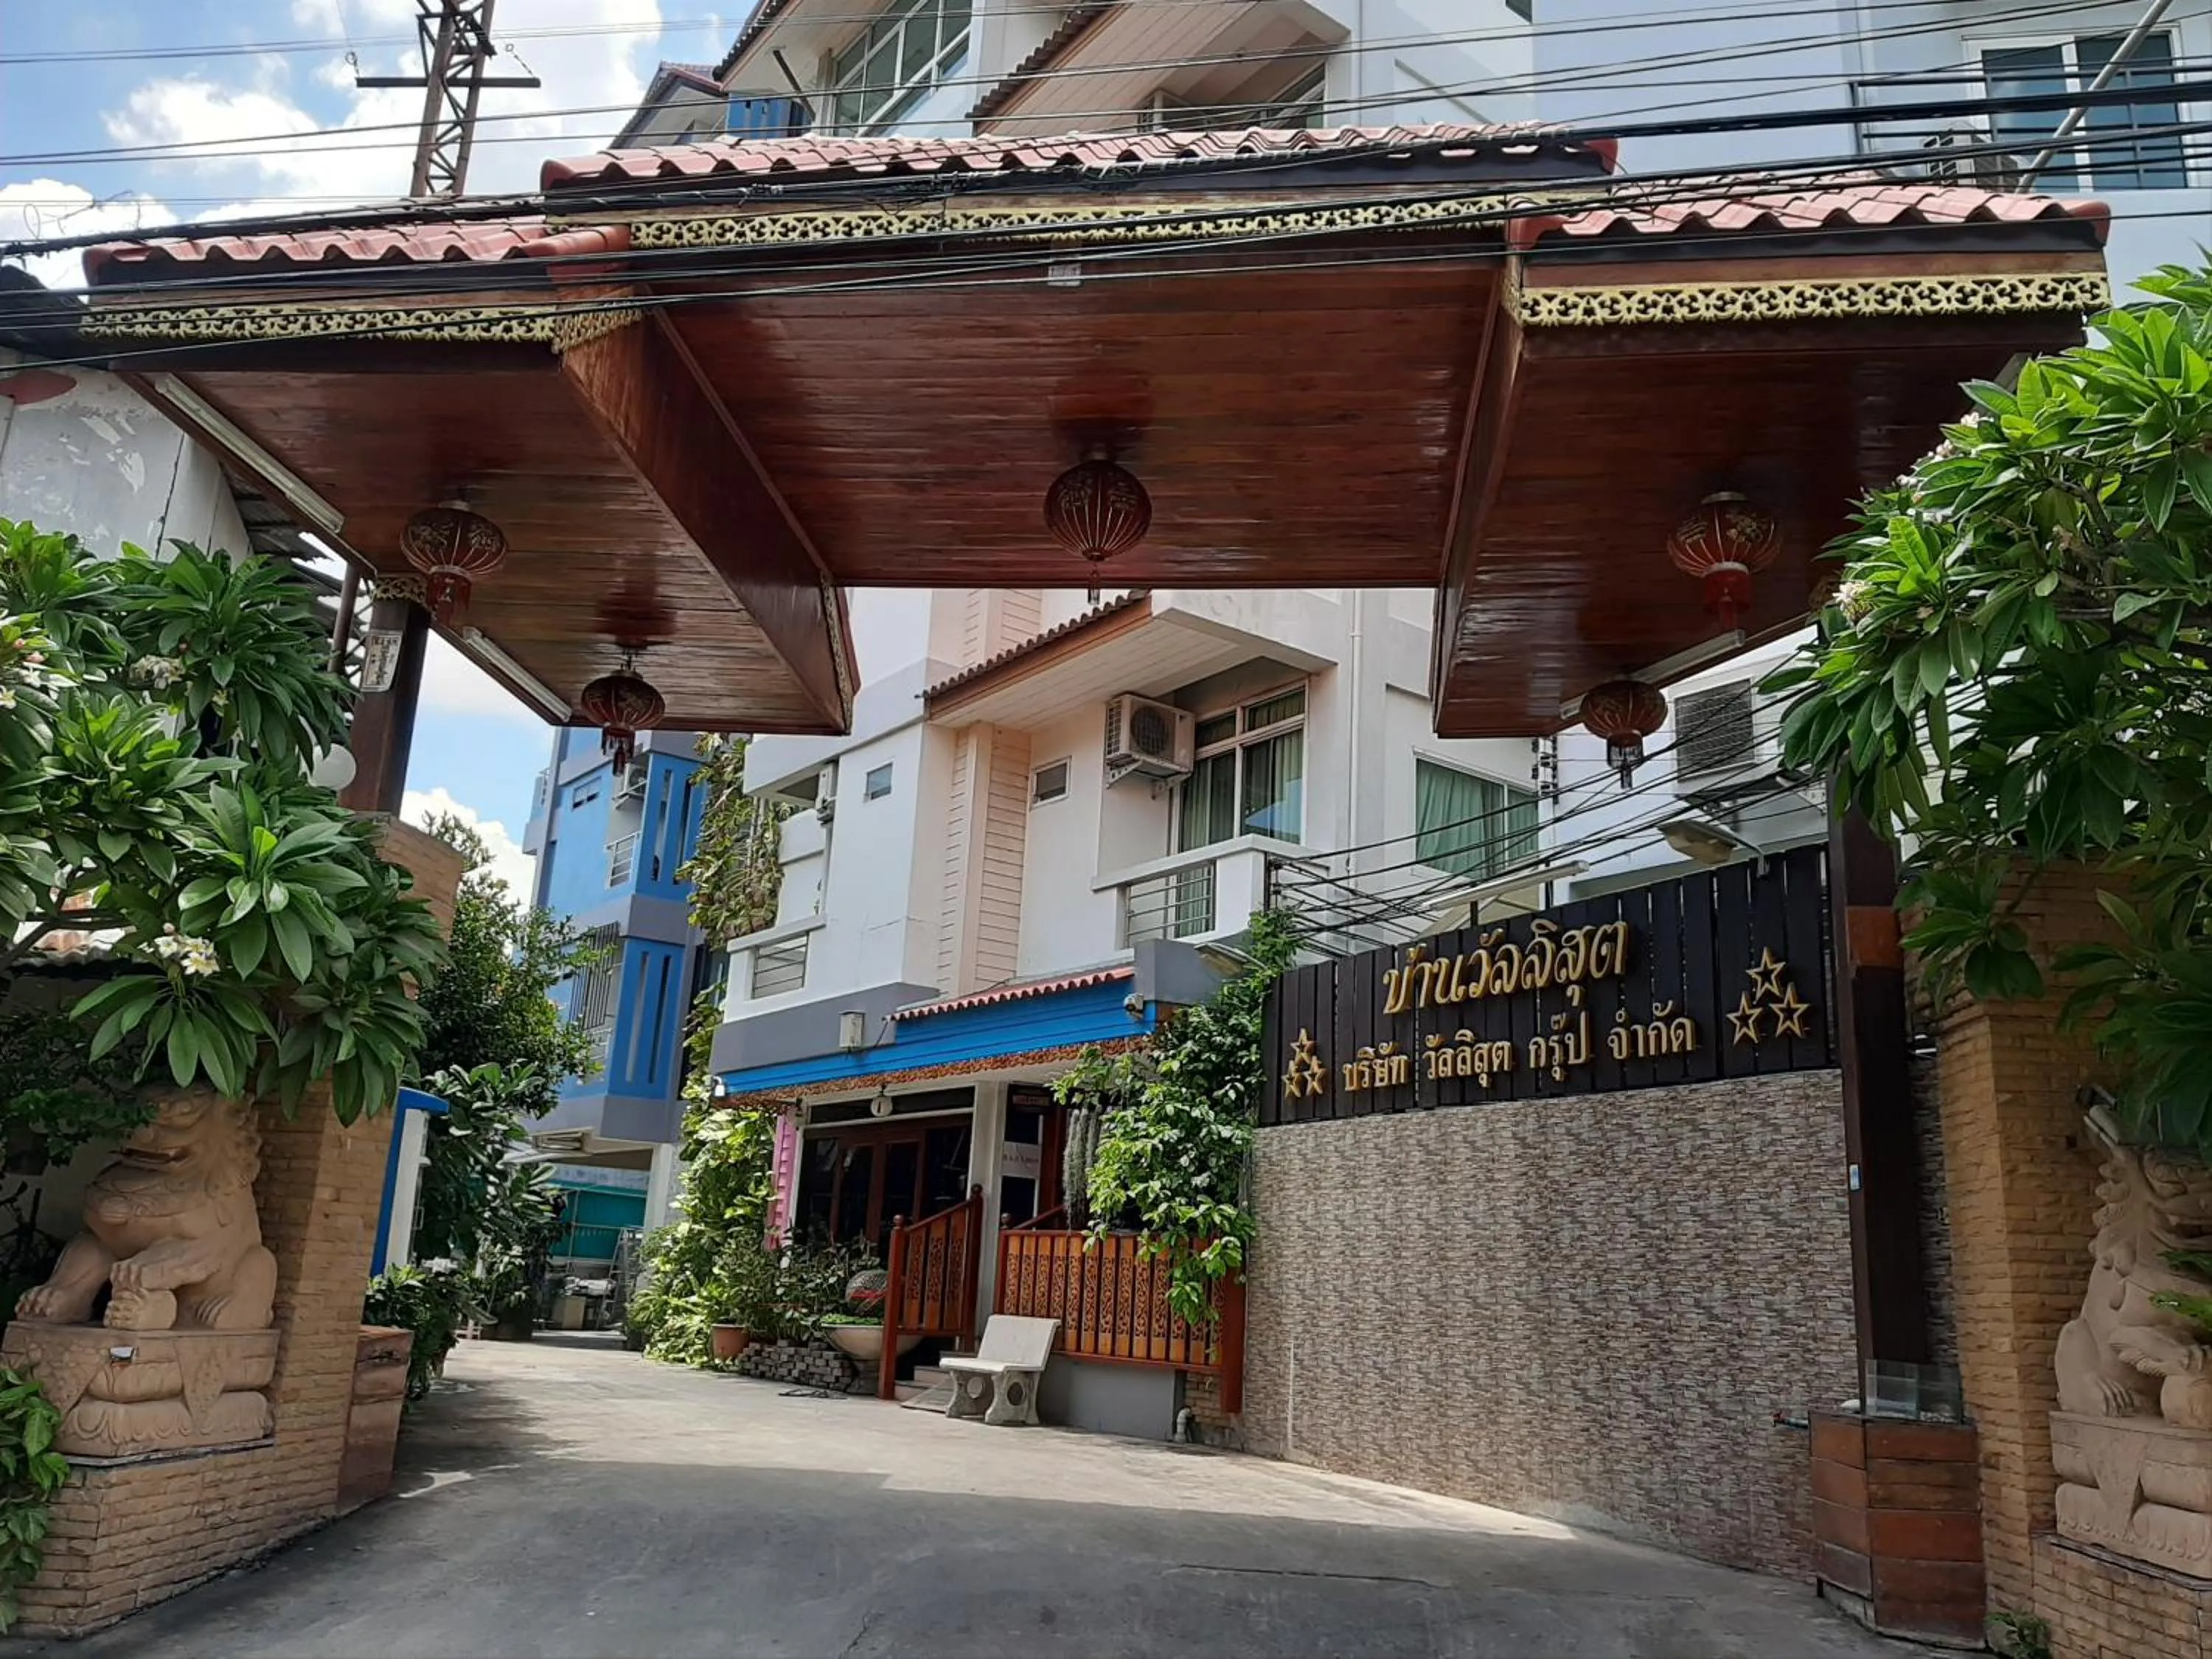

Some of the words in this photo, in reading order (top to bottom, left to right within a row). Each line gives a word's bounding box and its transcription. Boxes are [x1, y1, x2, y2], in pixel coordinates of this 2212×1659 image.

[1382, 919, 1628, 1015] บ้านวัลลิสุต
[1343, 1042, 1409, 1091] บริษัท
[1422, 1029, 1514, 1088] วัลลิสุต
[1528, 1010, 1590, 1082] กรุ๊ป
[1607, 1000, 1695, 1060] จำกัด
